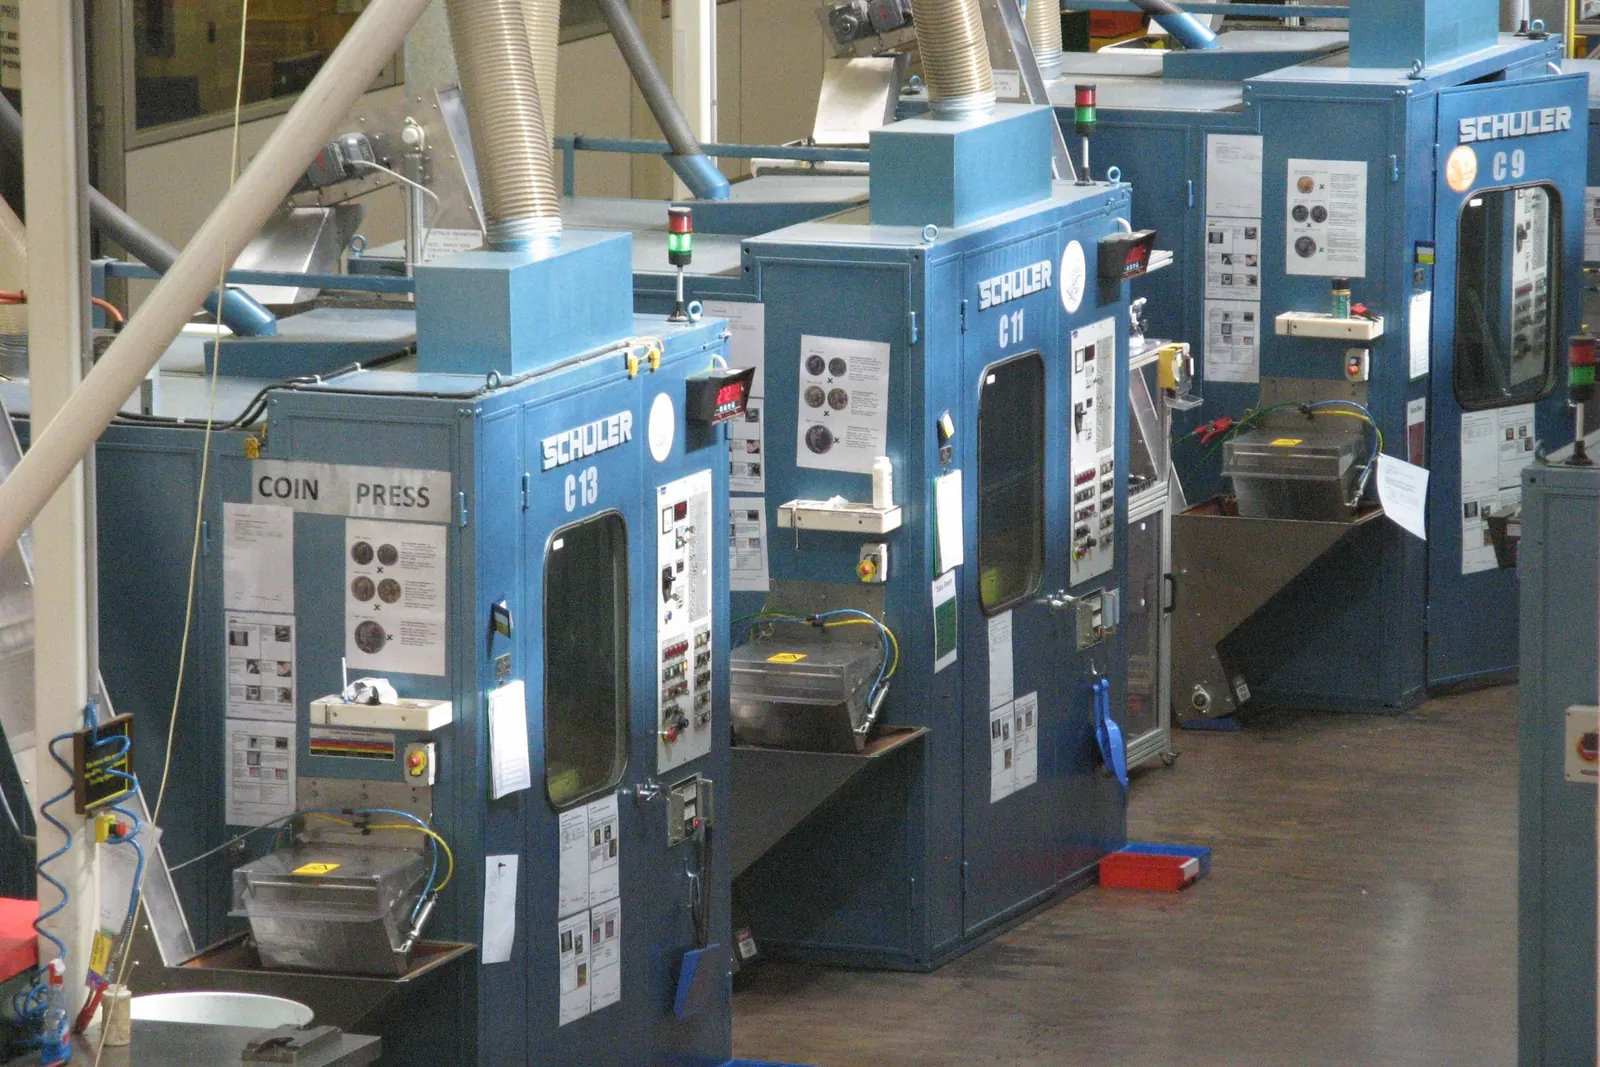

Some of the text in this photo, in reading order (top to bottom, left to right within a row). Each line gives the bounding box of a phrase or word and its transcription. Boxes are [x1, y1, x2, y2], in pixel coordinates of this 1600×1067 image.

[1460, 106, 1571, 143] SCHULER
[1493, 149, 1525, 181] C 9
[978, 260, 1052, 310] SCHULER
[999, 308, 1024, 348] C 11
[542, 410, 633, 470] SCHULER
[258, 475, 431, 508] COIN PRESS
[565, 466, 598, 512] C 13
